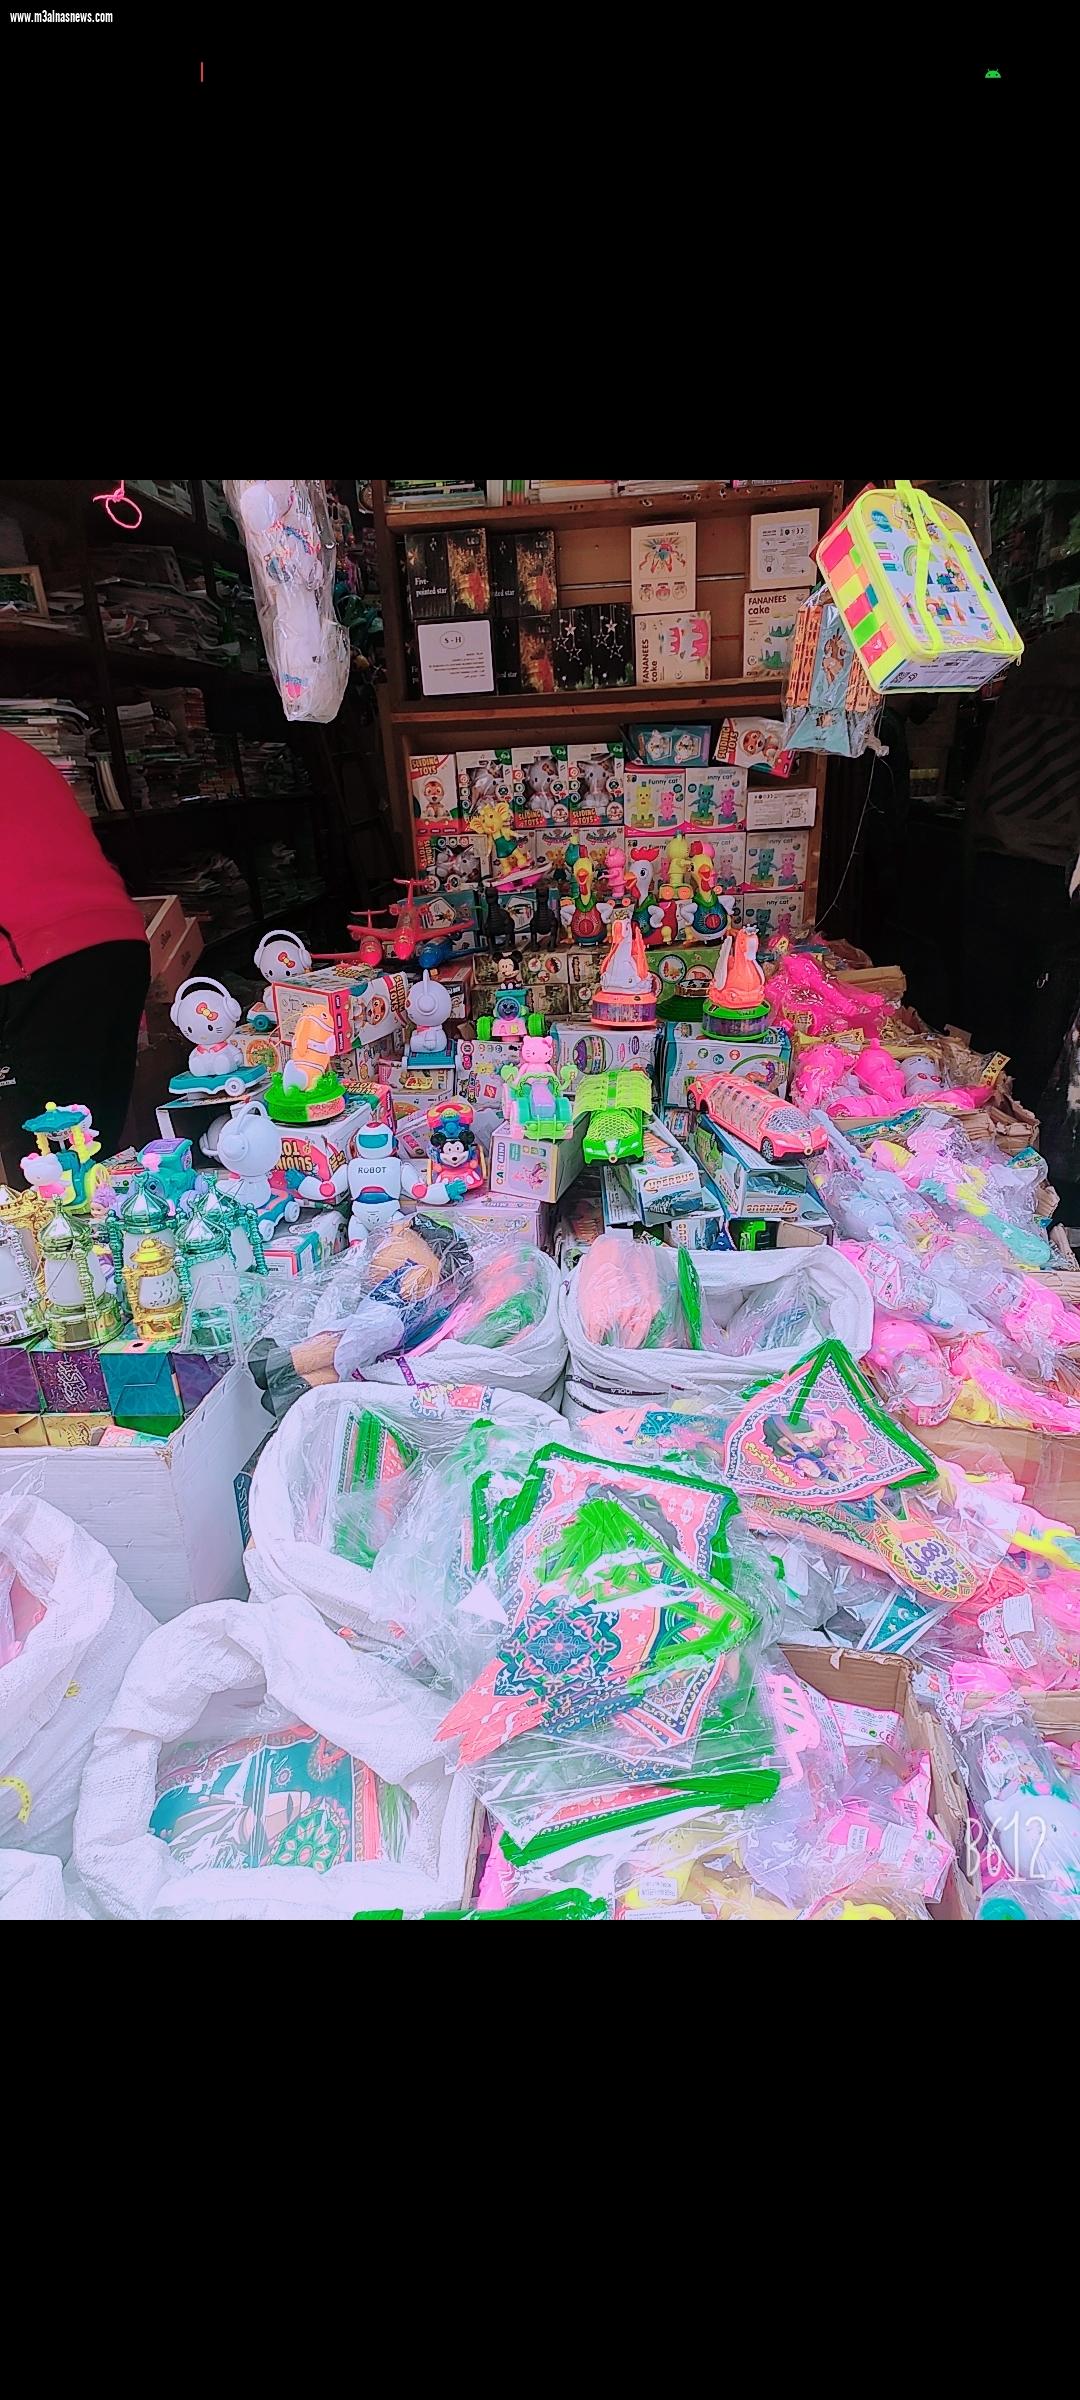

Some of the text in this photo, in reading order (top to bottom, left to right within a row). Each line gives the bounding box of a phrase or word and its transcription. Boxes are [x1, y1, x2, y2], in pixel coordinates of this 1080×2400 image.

[748, 594, 787, 605] FANANEES
[717, 726, 731, 759] SLIDING
[728, 730, 739, 753] TOYS
[411, 757, 439, 768] SLIDING
[419, 766, 437, 775] TOYS
[524, 818, 540, 826] TOYS
[578, 816, 594, 824] TOYS
[389, 987, 398, 1012] TOYS
[358, 1166, 387, 1174] ROBOT
[905, 1539, 948, 1575] رمضان
